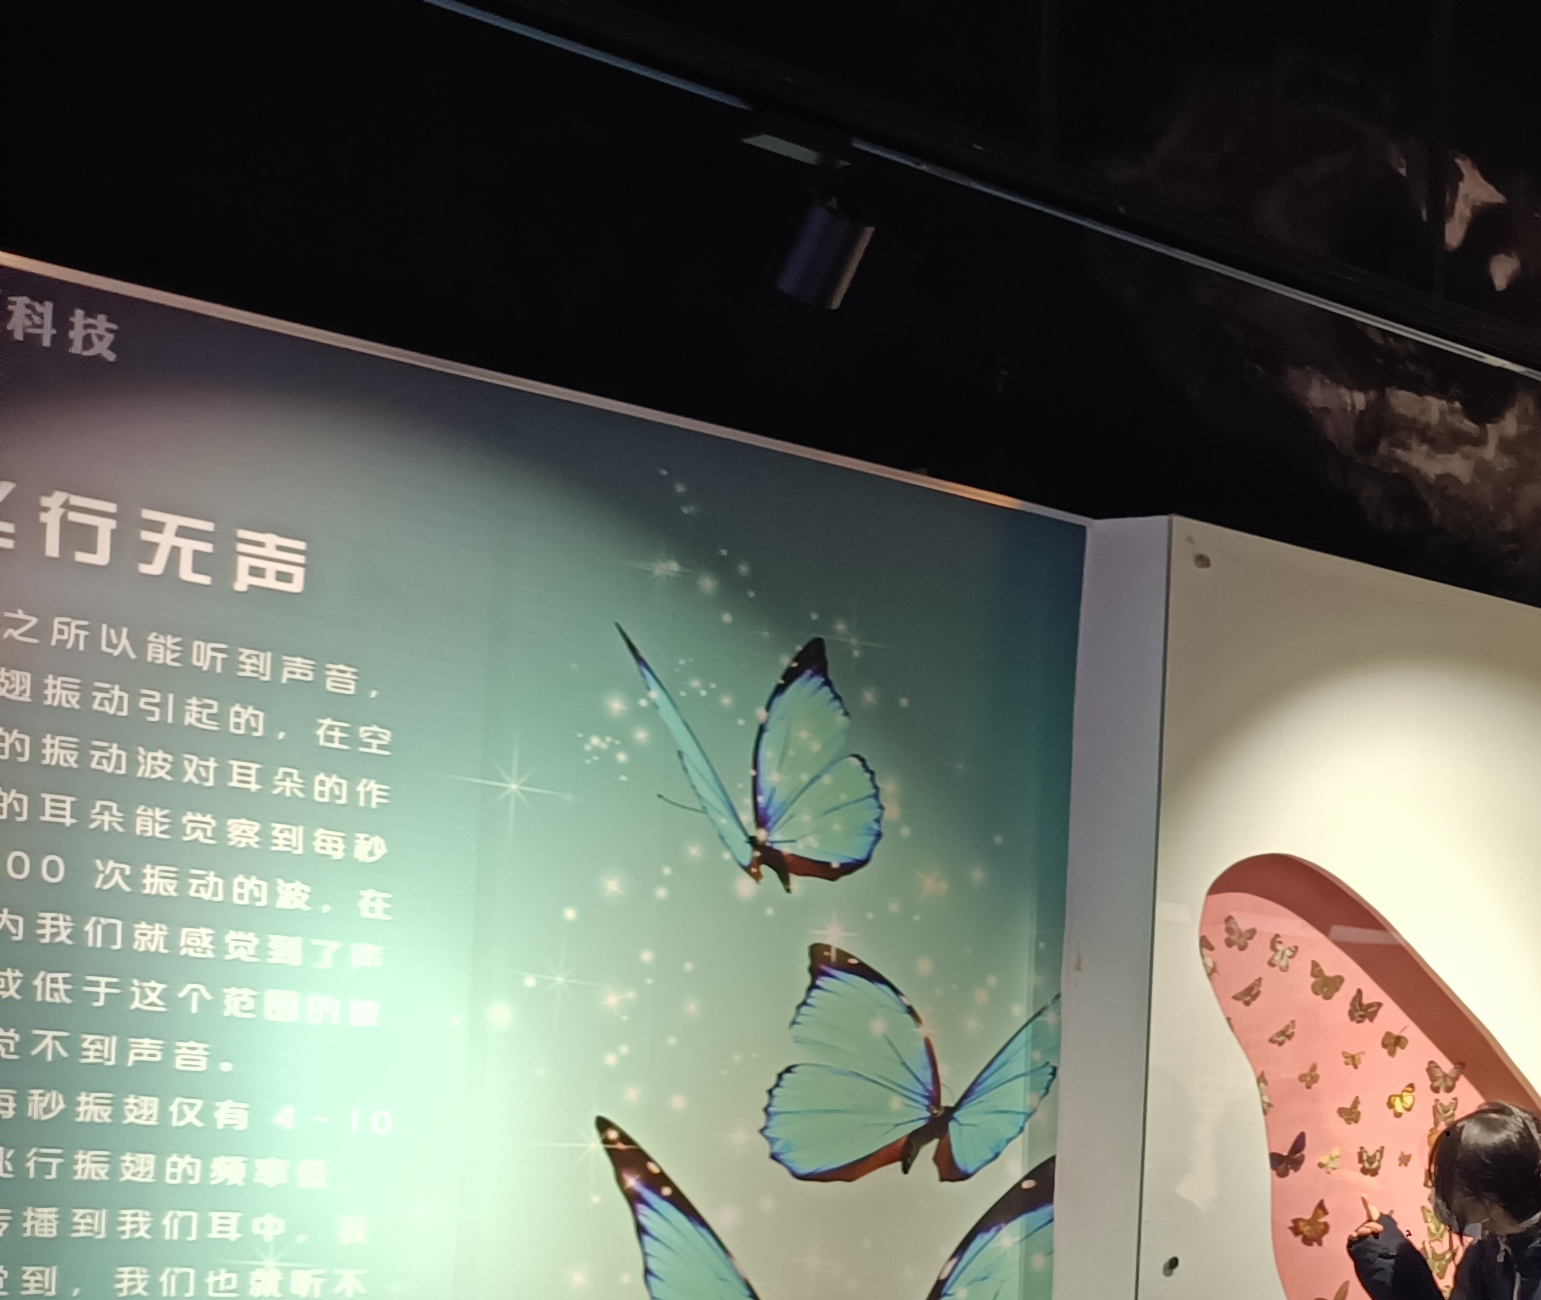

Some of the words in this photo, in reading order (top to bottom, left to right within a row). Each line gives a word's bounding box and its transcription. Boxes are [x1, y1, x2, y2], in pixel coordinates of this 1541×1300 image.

[8, 296, 119, 361] 科技
[0, 1266, 367, 1298] 到，我们也就听不
